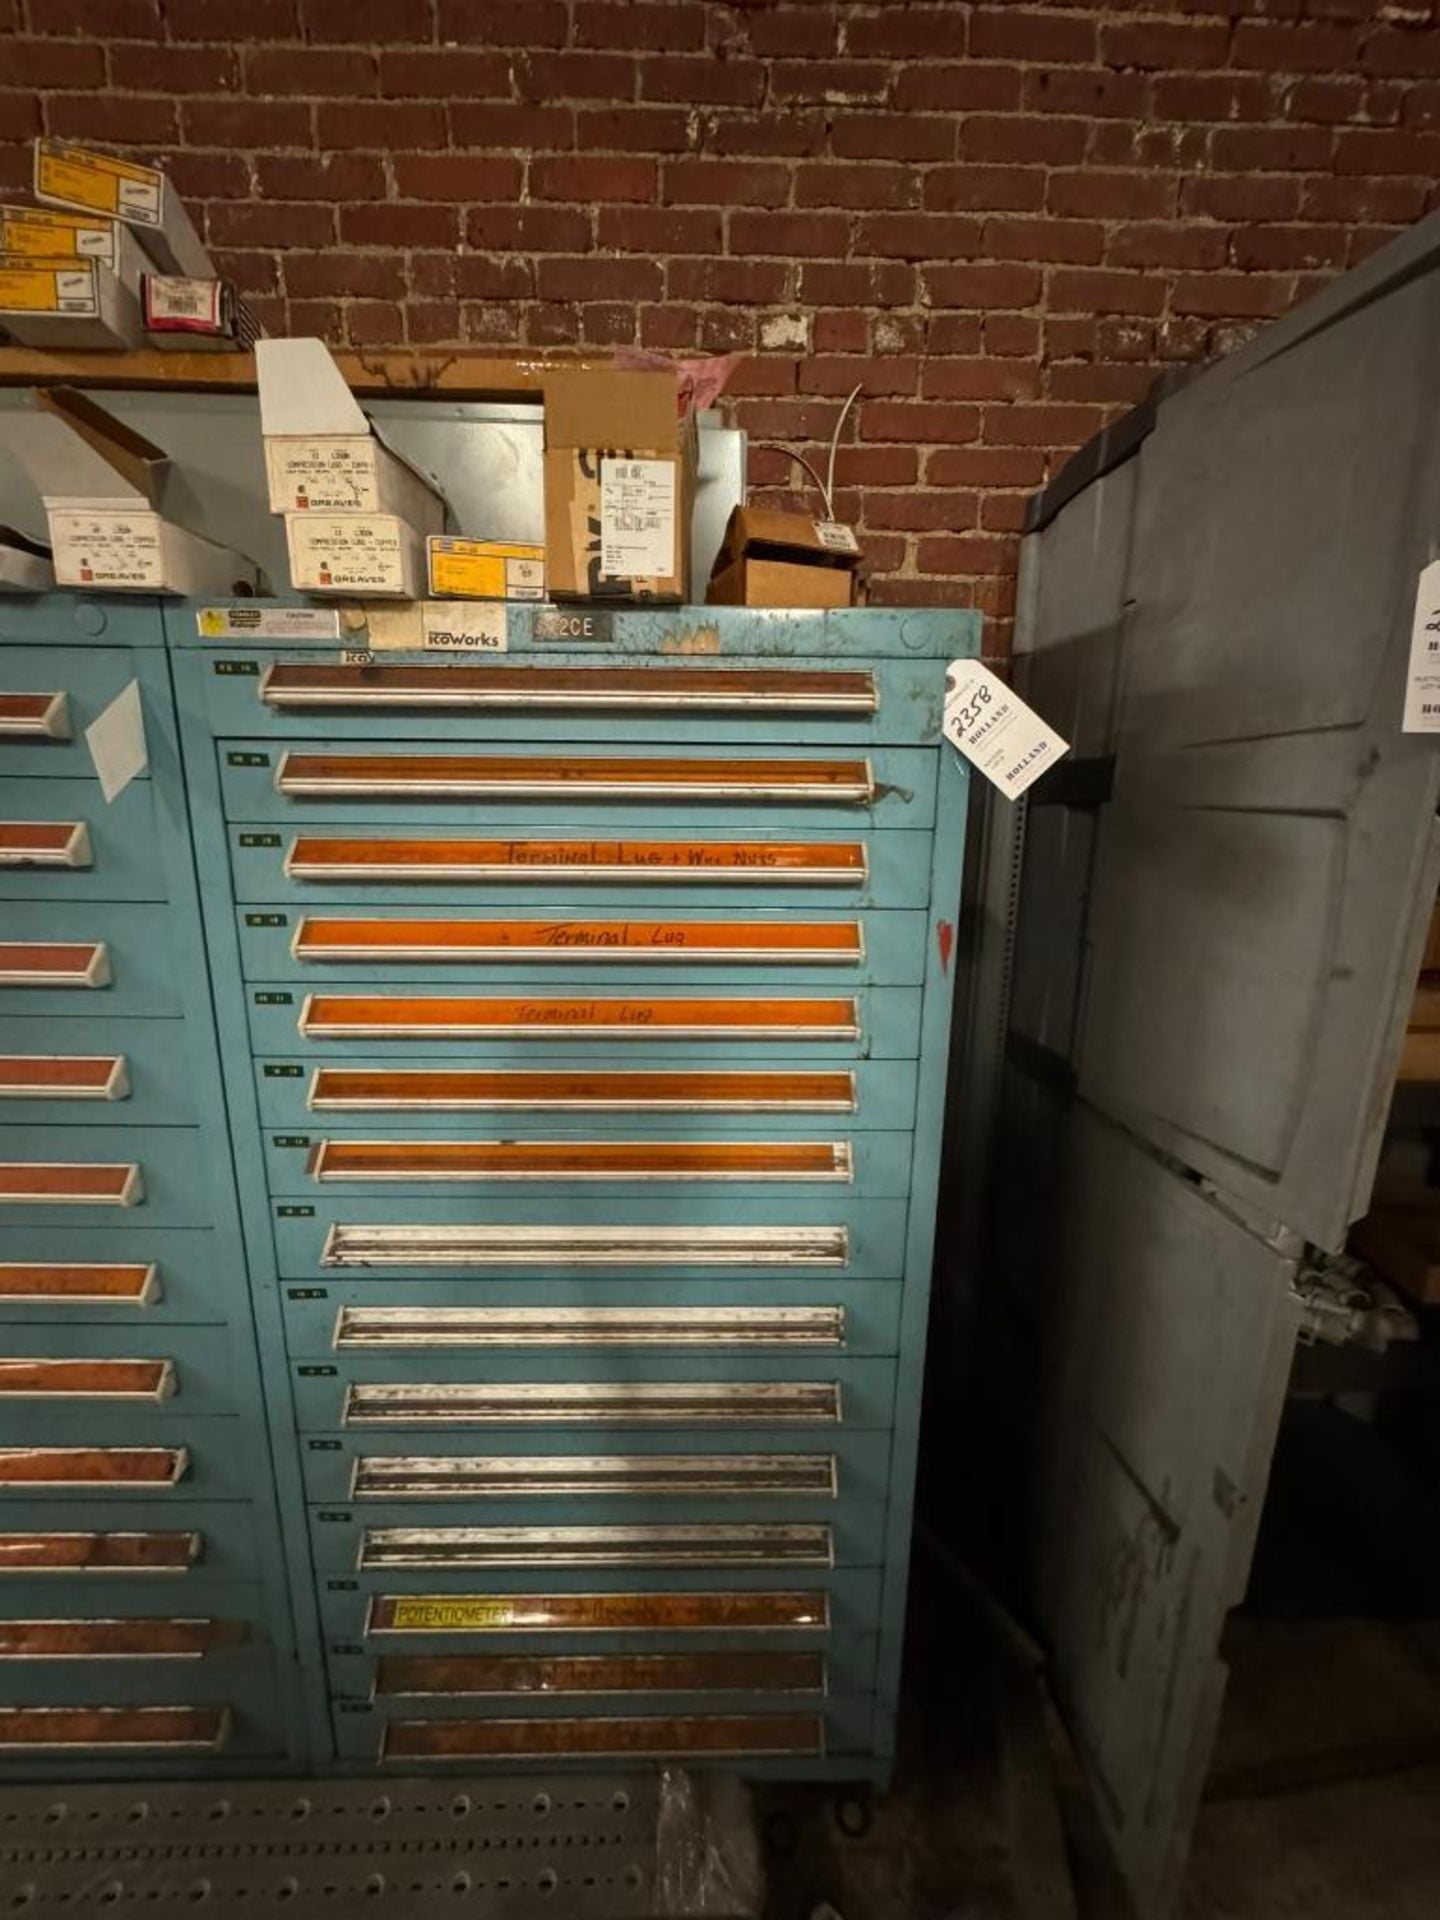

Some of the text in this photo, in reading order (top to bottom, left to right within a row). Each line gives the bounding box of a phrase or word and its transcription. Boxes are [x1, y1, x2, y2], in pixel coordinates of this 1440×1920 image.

[311, 499, 362, 507] GREAVES
[334, 575, 386, 583] GREAVES
[950, 684, 992, 739] 2358
[968, 703, 1010, 746] HOLLAND
[1005, 740, 1048, 782] HOLLAND
